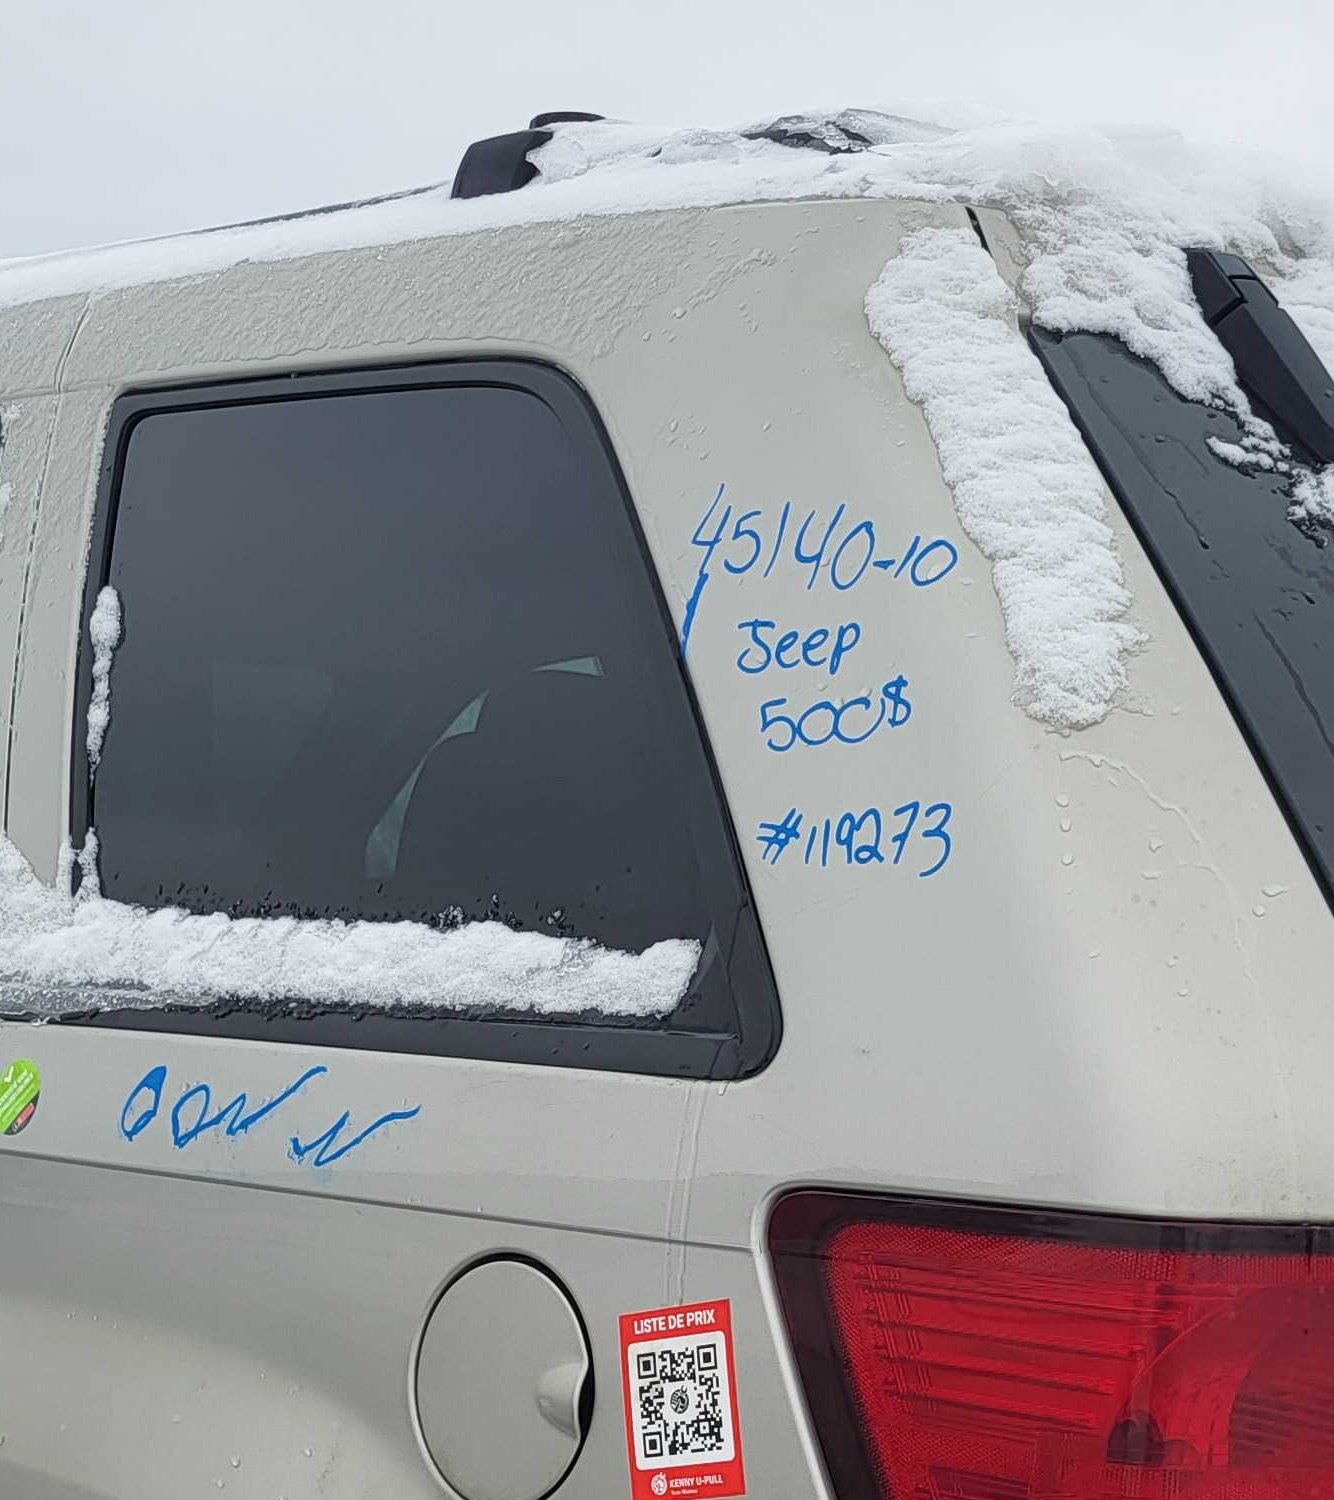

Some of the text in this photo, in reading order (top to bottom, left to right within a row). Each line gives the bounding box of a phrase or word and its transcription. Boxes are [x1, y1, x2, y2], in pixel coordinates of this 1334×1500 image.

[736, 618, 862, 675] Jeep
[759, 675, 912, 753] 500$
[755, 801, 954, 877] #119273
[633, 1308, 716, 1335] LISTE DE PRIX
[669, 1474, 724, 1488] KENNY U-PULL
